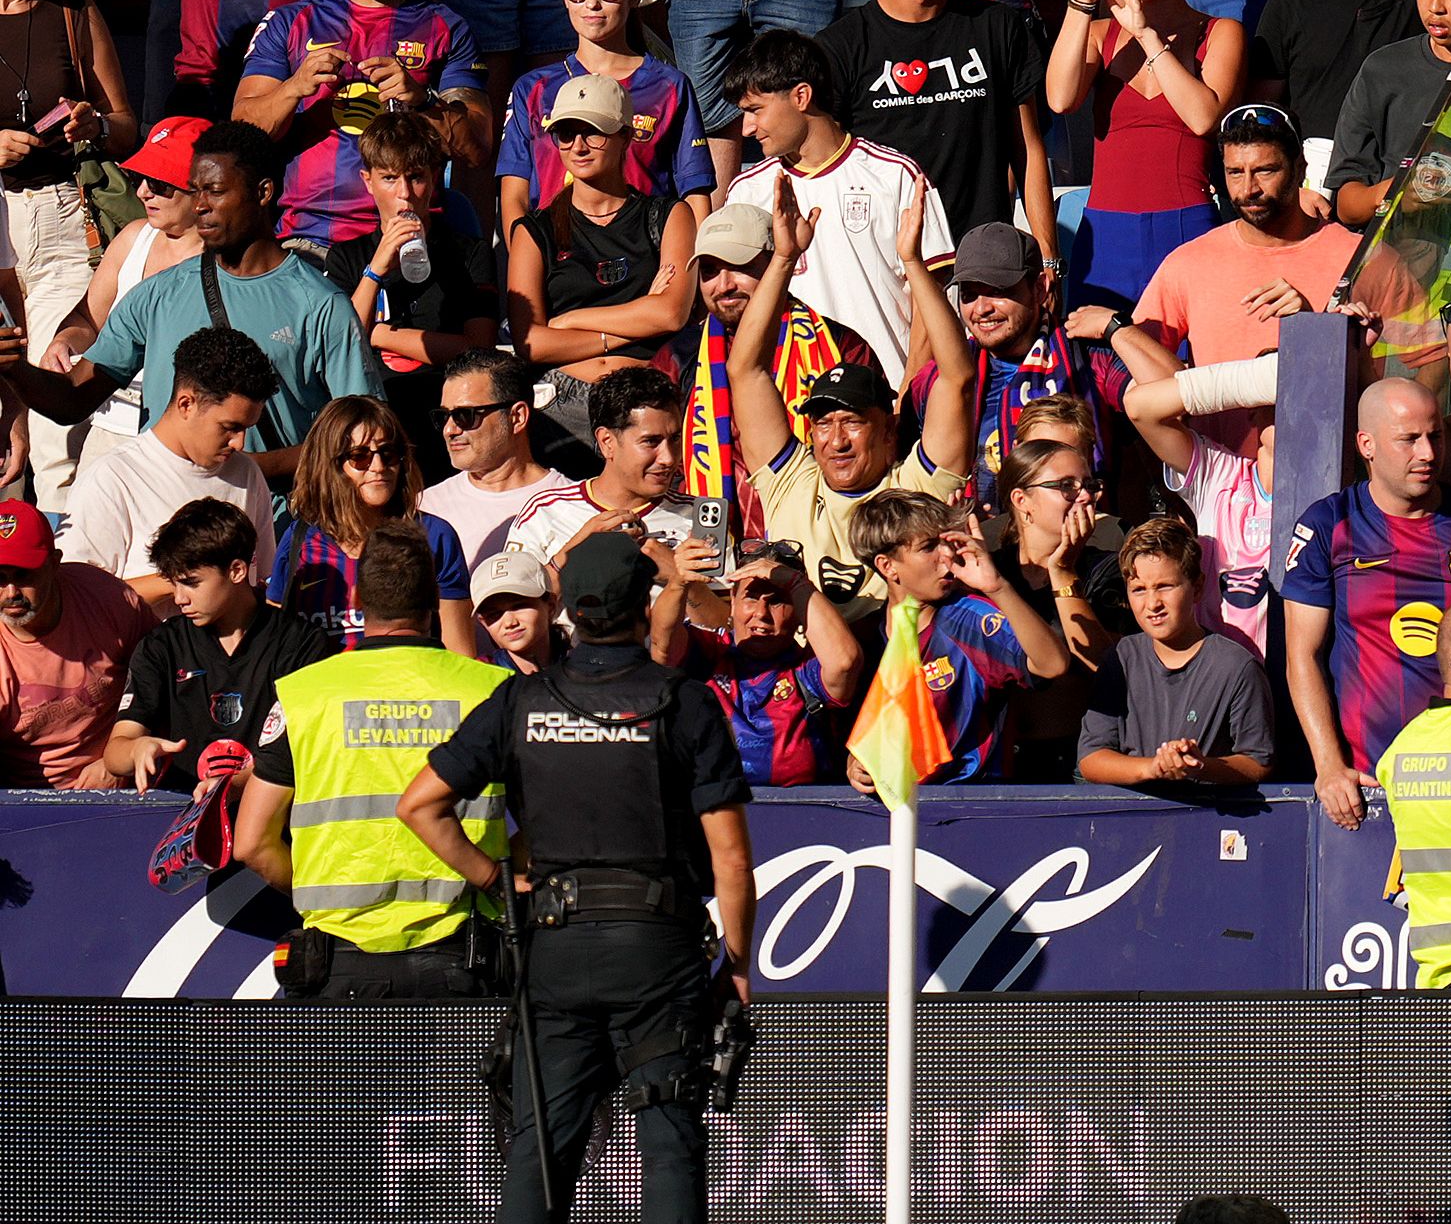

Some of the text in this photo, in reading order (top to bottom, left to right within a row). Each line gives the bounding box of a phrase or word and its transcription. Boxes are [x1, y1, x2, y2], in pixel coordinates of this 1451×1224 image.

[872, 87, 987, 109] COMME des GARÇONS
[365, 704, 432, 720] GRUPO
[526, 727, 649, 743] NACIONAL
[1401, 757, 1446, 773] GRUPO
